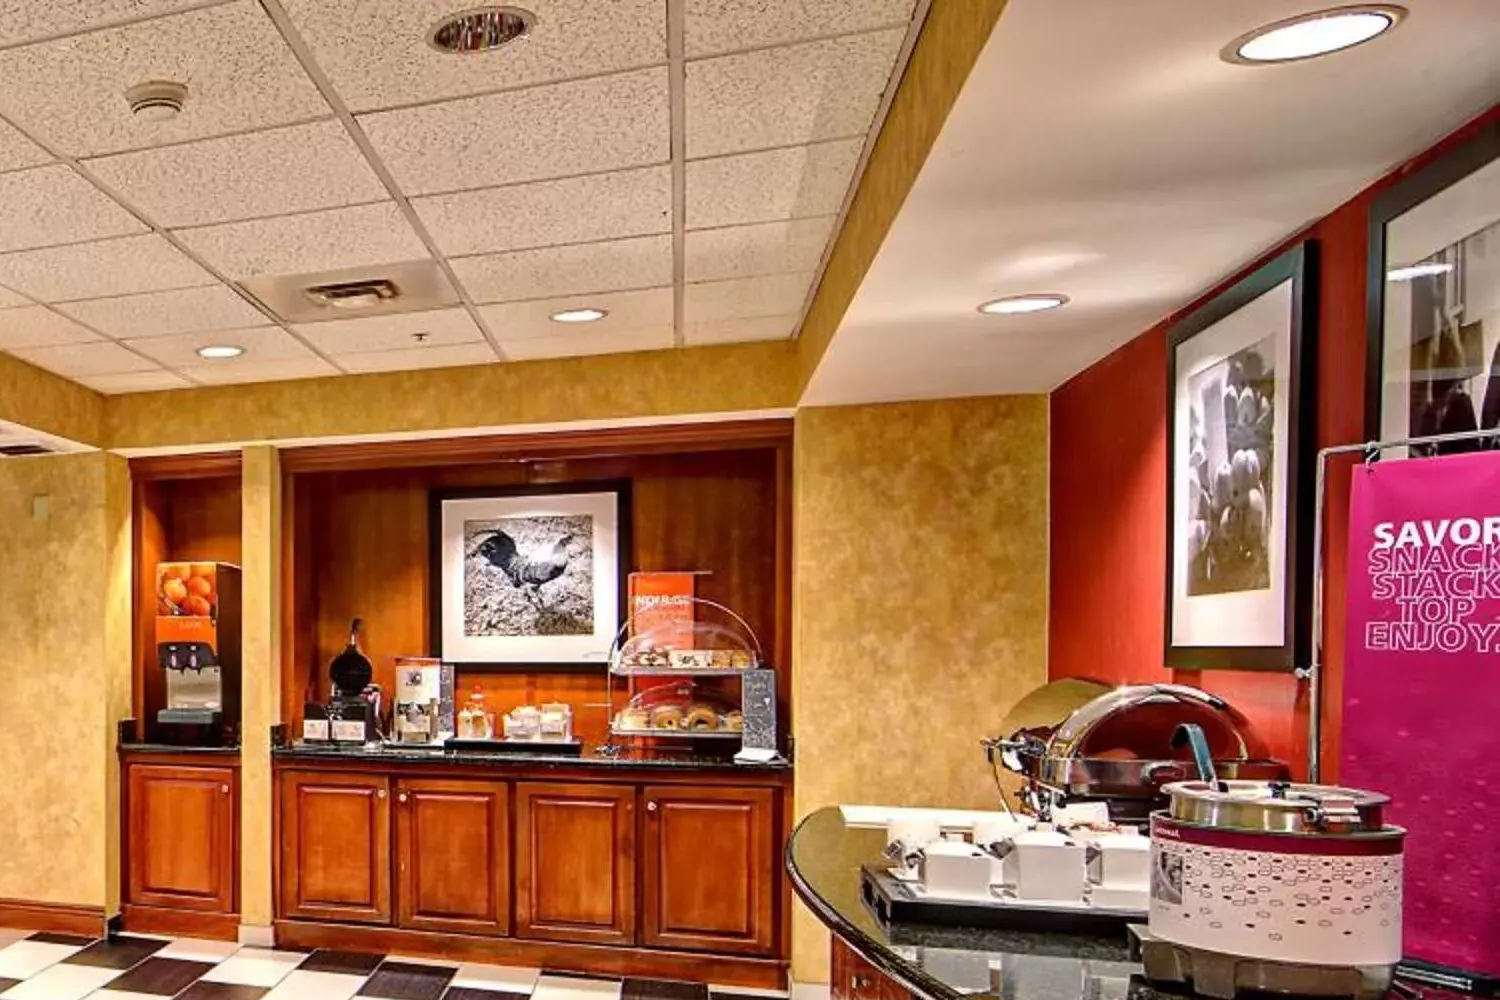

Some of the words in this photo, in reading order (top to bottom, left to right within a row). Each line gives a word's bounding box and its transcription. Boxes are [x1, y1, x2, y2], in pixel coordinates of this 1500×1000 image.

[1373, 517, 1500, 549] SAVOR
[1367, 542, 1500, 574] SNACK
[1371, 568, 1500, 599] STACK
[1395, 596, 1477, 625] TOP
